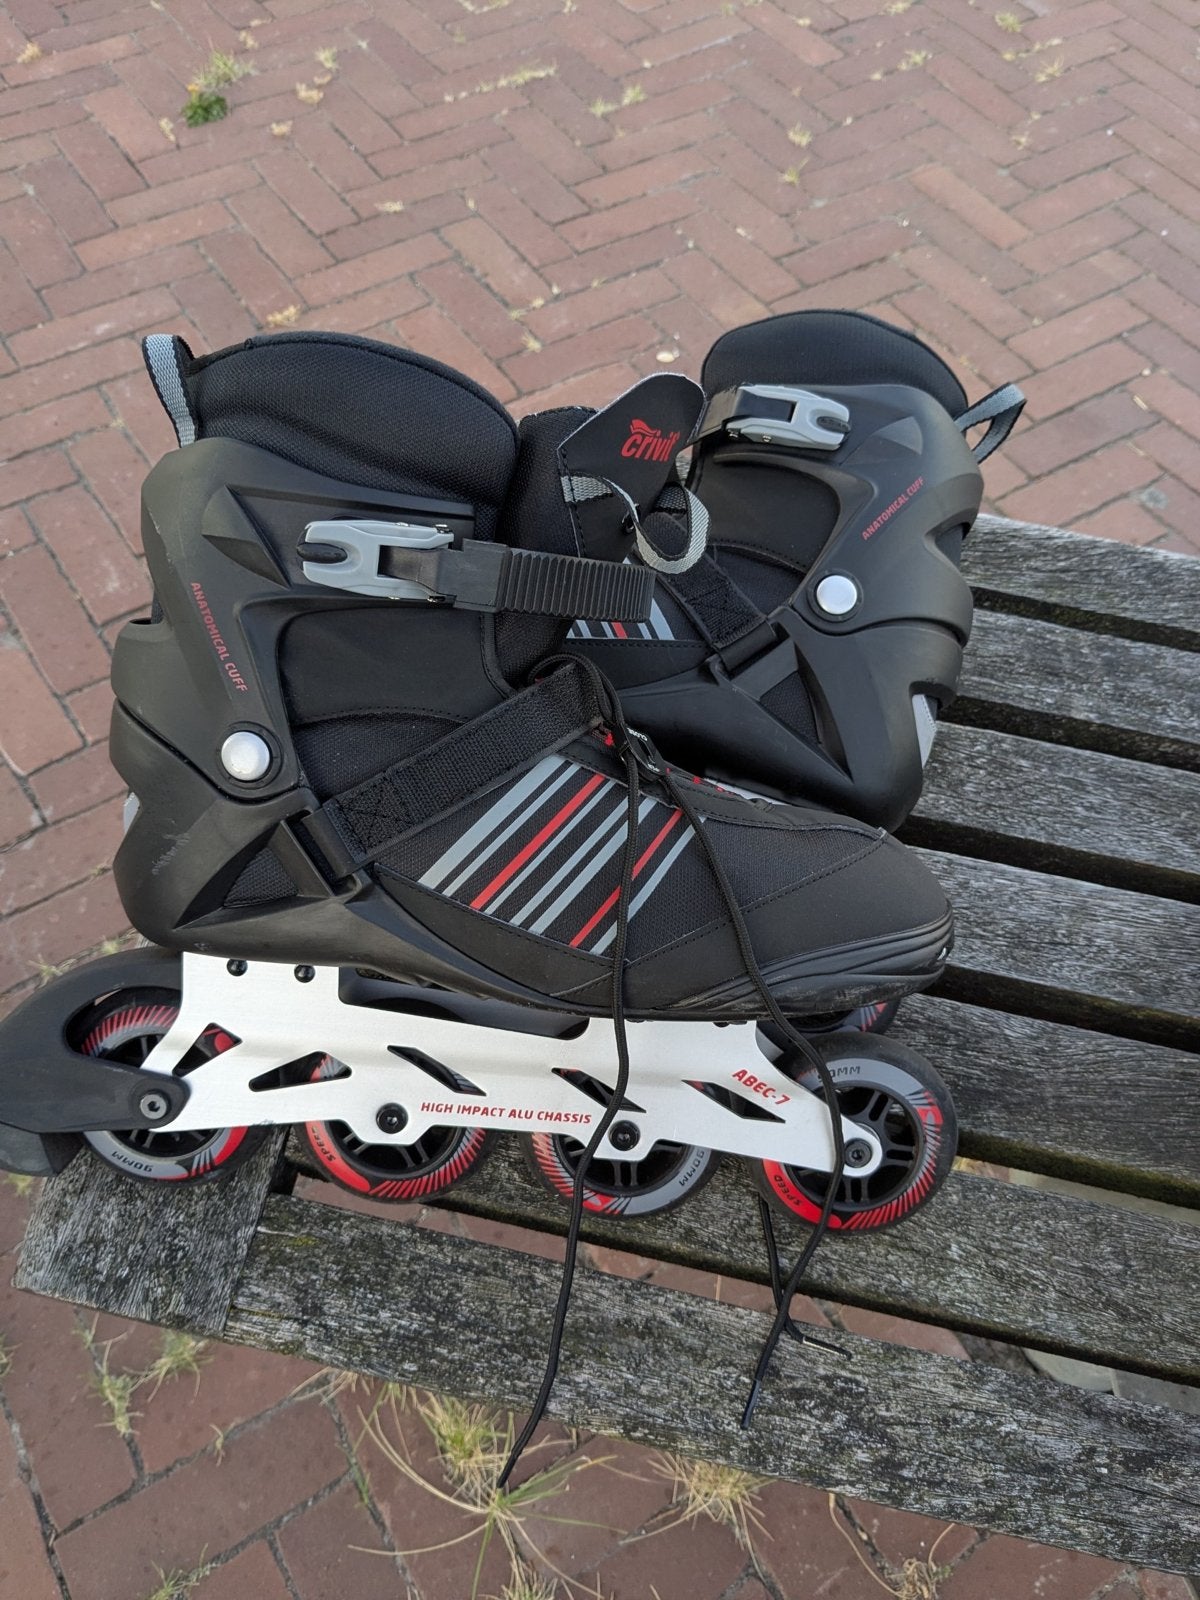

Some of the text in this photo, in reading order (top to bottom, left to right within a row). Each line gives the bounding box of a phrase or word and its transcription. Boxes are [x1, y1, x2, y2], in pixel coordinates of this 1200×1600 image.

[862, 476, 924, 541] ANATOMICAL CUFF
[191, 582, 248, 692] ANATOMICAL CUFF
[732, 1069, 791, 1105] ABEC-7
[421, 1102, 592, 1124] HIGH IMPACT ALU CHASSIS
[111, 1151, 154, 1172] 90MM
[678, 1150, 705, 1186] 90MM
[774, 1174, 803, 1206] SPEED
